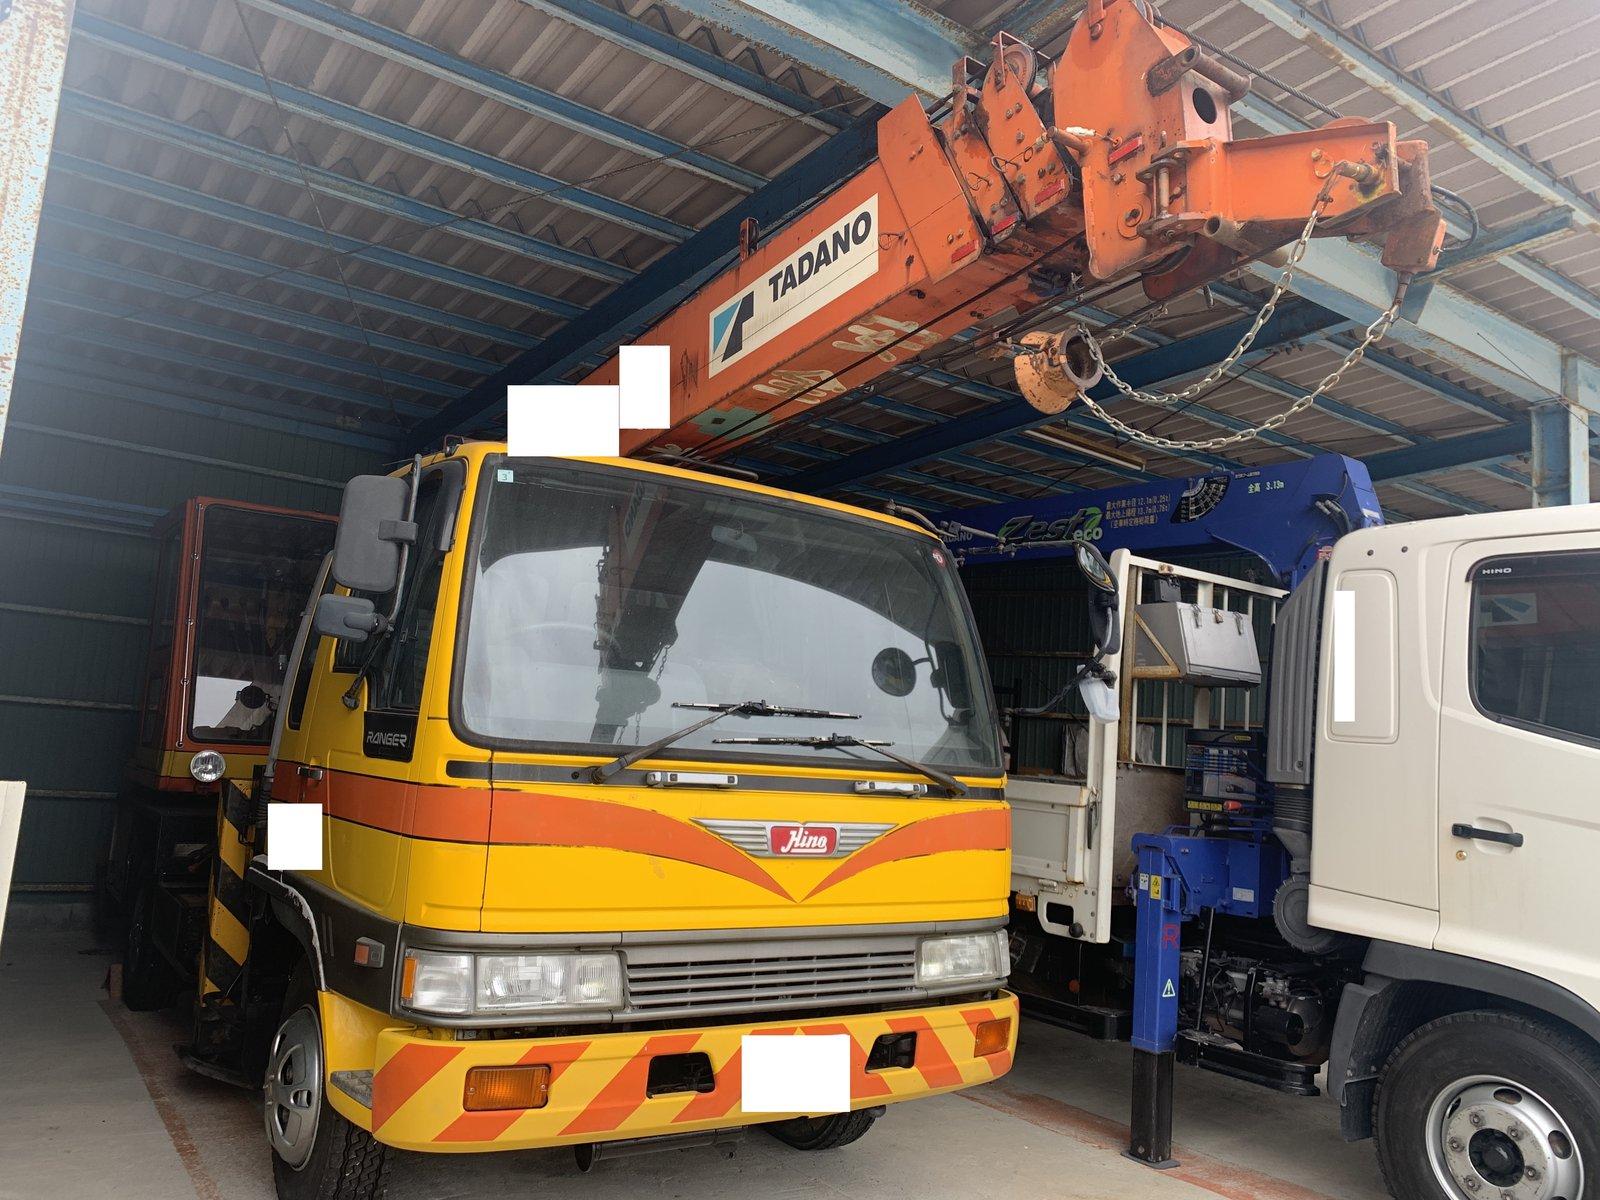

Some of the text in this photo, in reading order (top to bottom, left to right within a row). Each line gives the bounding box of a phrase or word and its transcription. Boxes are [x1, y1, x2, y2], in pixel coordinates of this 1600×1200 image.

[768, 211, 872, 303] TADANO
[998, 508, 1103, 542] Zest eco
[1482, 567, 1512, 575] HINO
[366, 731, 408, 748] RANGER
[781, 827, 828, 853] Hino
